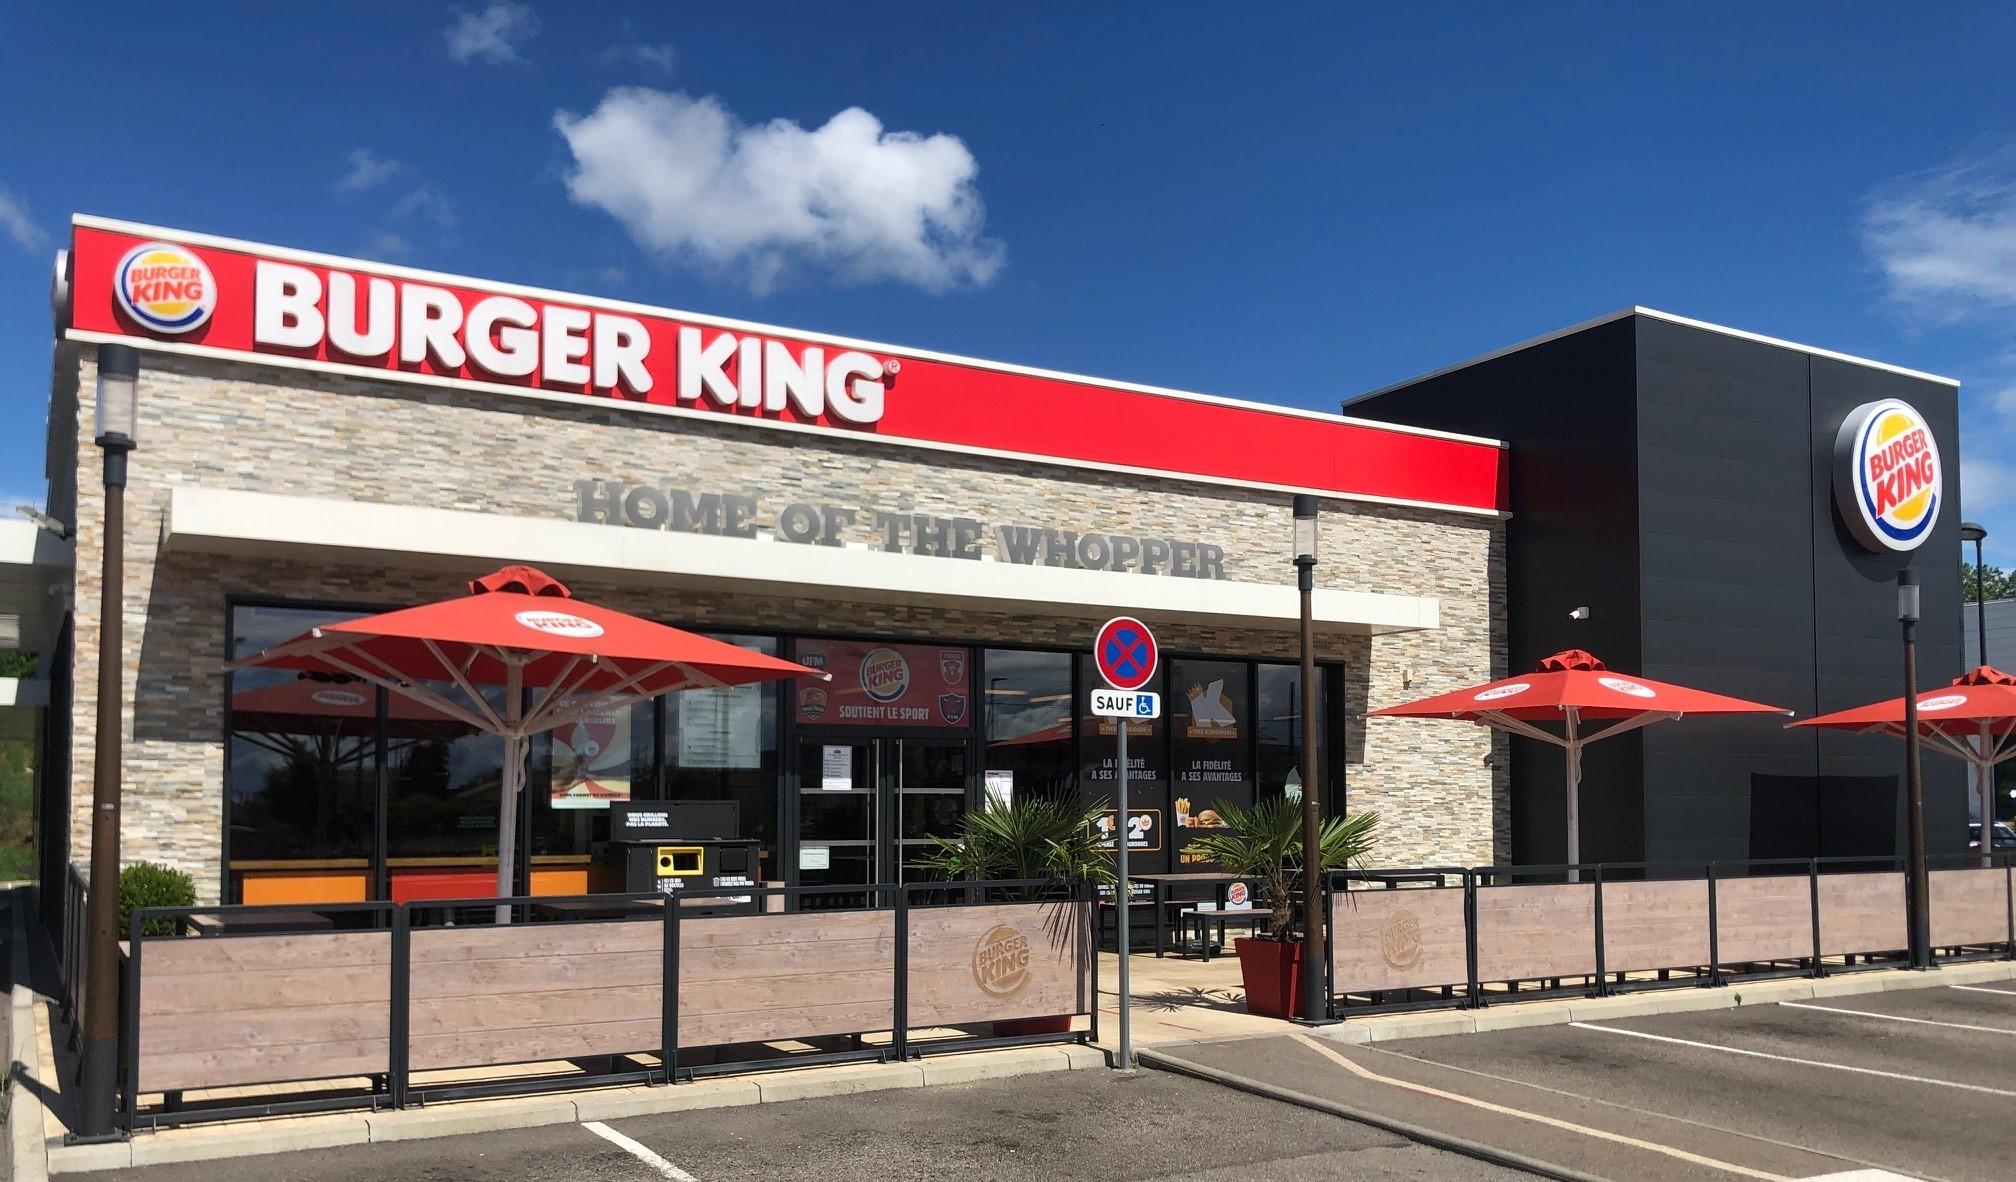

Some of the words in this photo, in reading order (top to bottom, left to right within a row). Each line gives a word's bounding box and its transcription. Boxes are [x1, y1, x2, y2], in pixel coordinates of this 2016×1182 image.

[131, 266, 201, 282] BURGER
[132, 281, 204, 304] KING
[254, 260, 654, 394] BURGER
[1869, 428, 1928, 483] BURGER
[1875, 450, 1934, 518] KING
[576, 480, 758, 539] HOME
[779, 502, 856, 546] OF
[873, 512, 983, 560] THE
[998, 524, 1225, 581] WHOPPER
[866, 659, 903, 677] BURGER
[867, 668, 904, 689] KING
[839, 705, 885, 719] SOUTIENT
[887, 707, 898, 719] LE
[900, 707, 929, 720] SPORT
[1096, 696, 1134, 711] SAUF
[1102, 759, 1113, 769] LA
[1192, 760, 1201, 770] LA
[1203, 759, 1232, 771] FIDÉLITÉ
[1091, 770, 1098, 780] A
[1099, 770, 1113, 780] SES
[1181, 771, 1187, 781] A
[1188, 771, 1201, 781] SES
[1203, 771, 1242, 782] AVANTAGES
[979, 935, 1028, 966] BURGER
[980, 949, 1031, 986] KING
